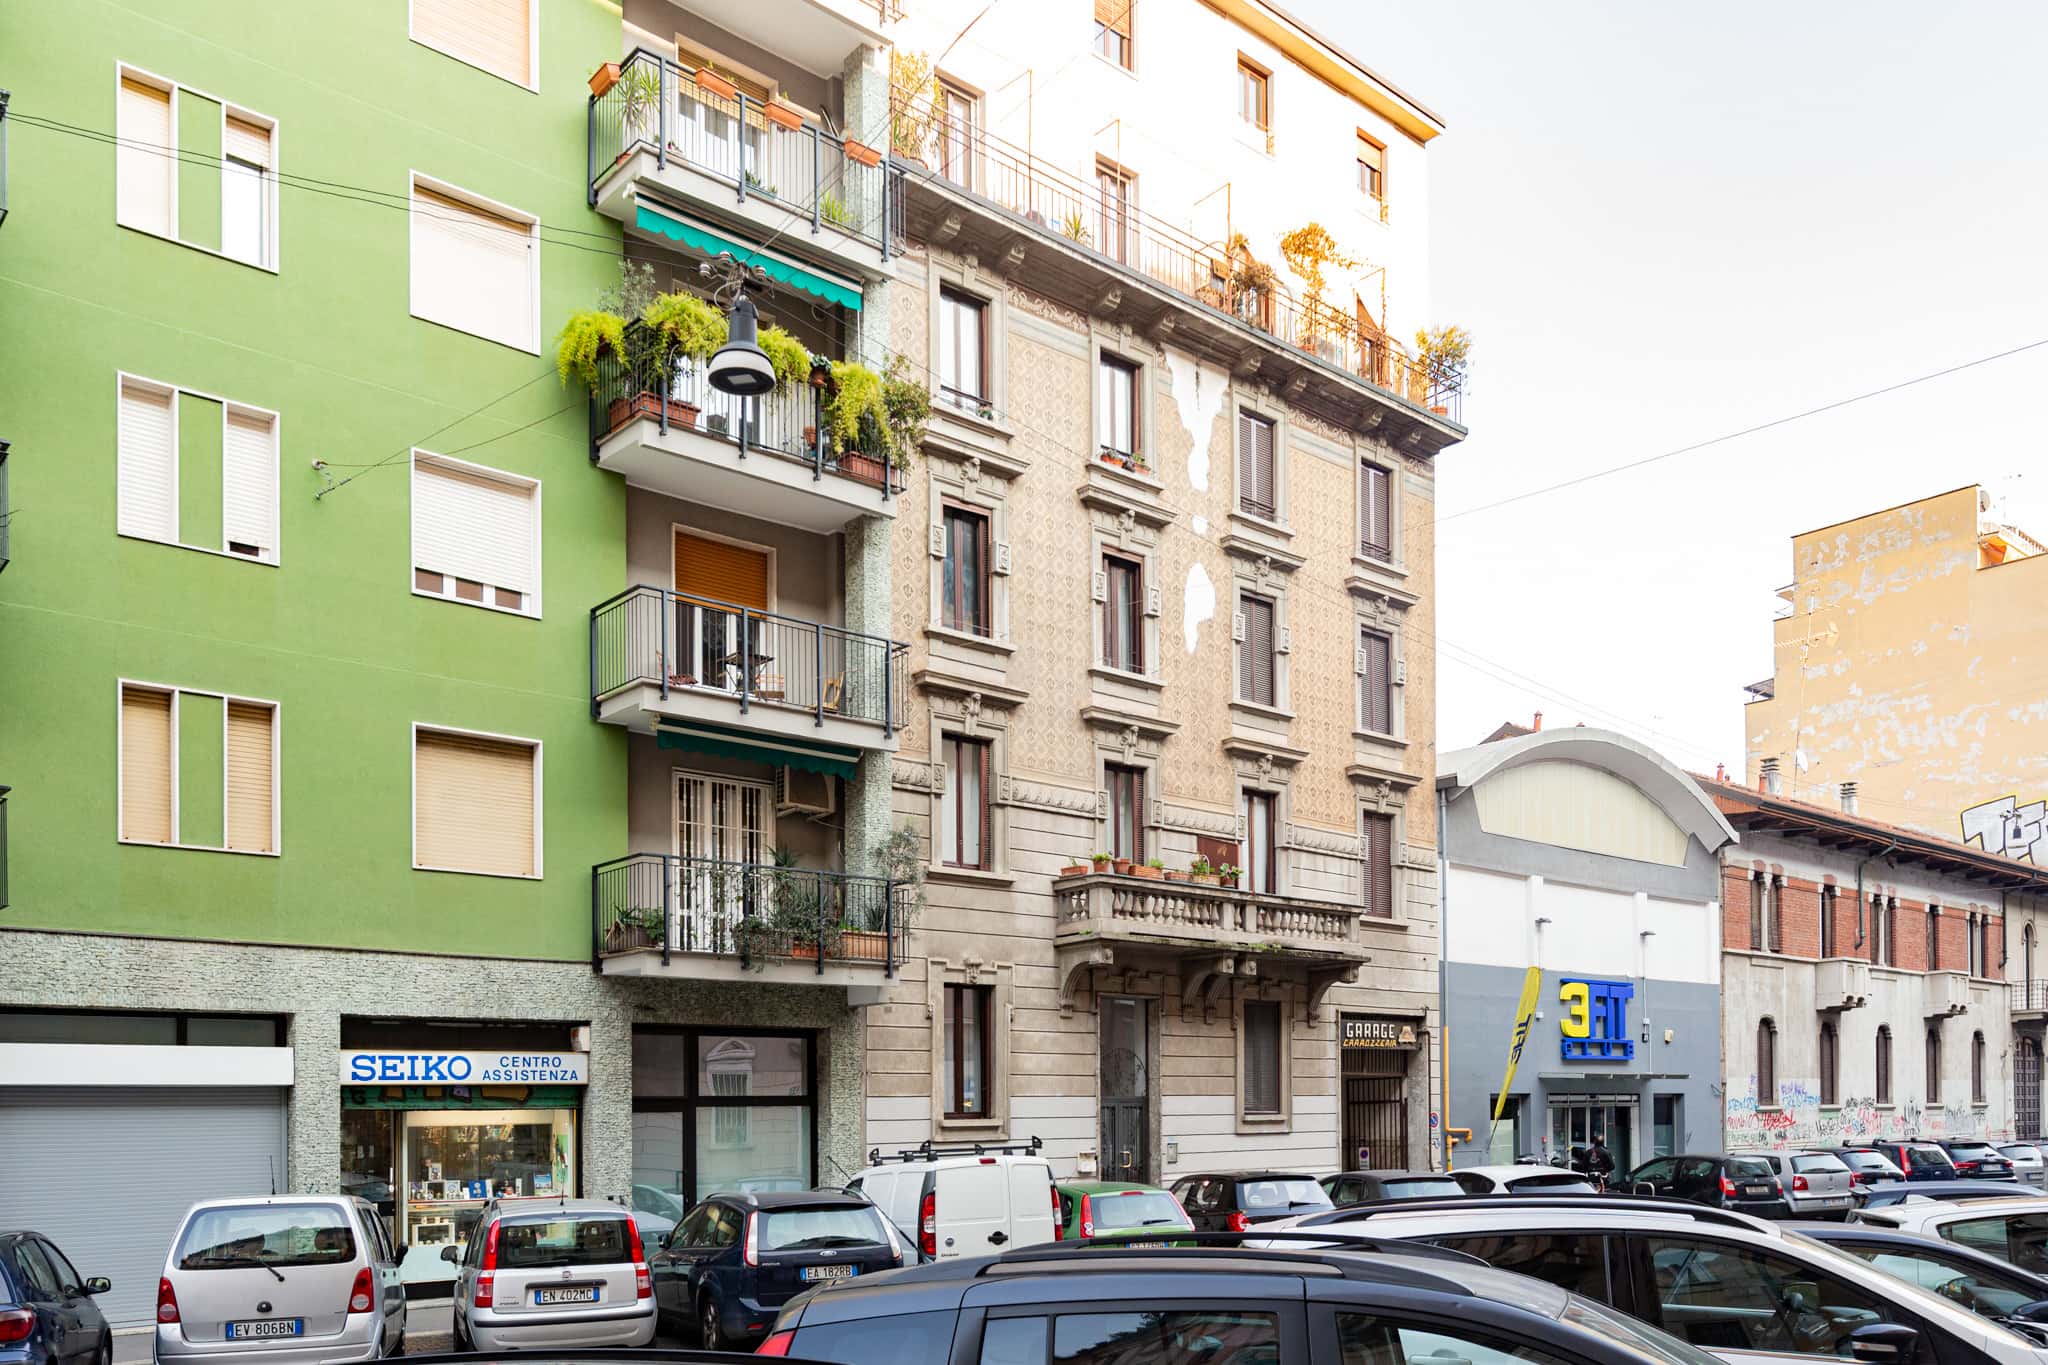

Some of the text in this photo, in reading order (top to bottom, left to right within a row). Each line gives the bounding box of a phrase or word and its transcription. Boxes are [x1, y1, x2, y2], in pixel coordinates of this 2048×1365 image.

[1346, 1022, 1395, 1038] GARAGE
[351, 1054, 472, 1082] SEIKO
[500, 1056, 562, 1068] CENTRO
[482, 1070, 578, 1081] ASSISTENZA
[542, 1289, 592, 1302] EN 402MC
[235, 1322, 294, 1337] EV 806BN
